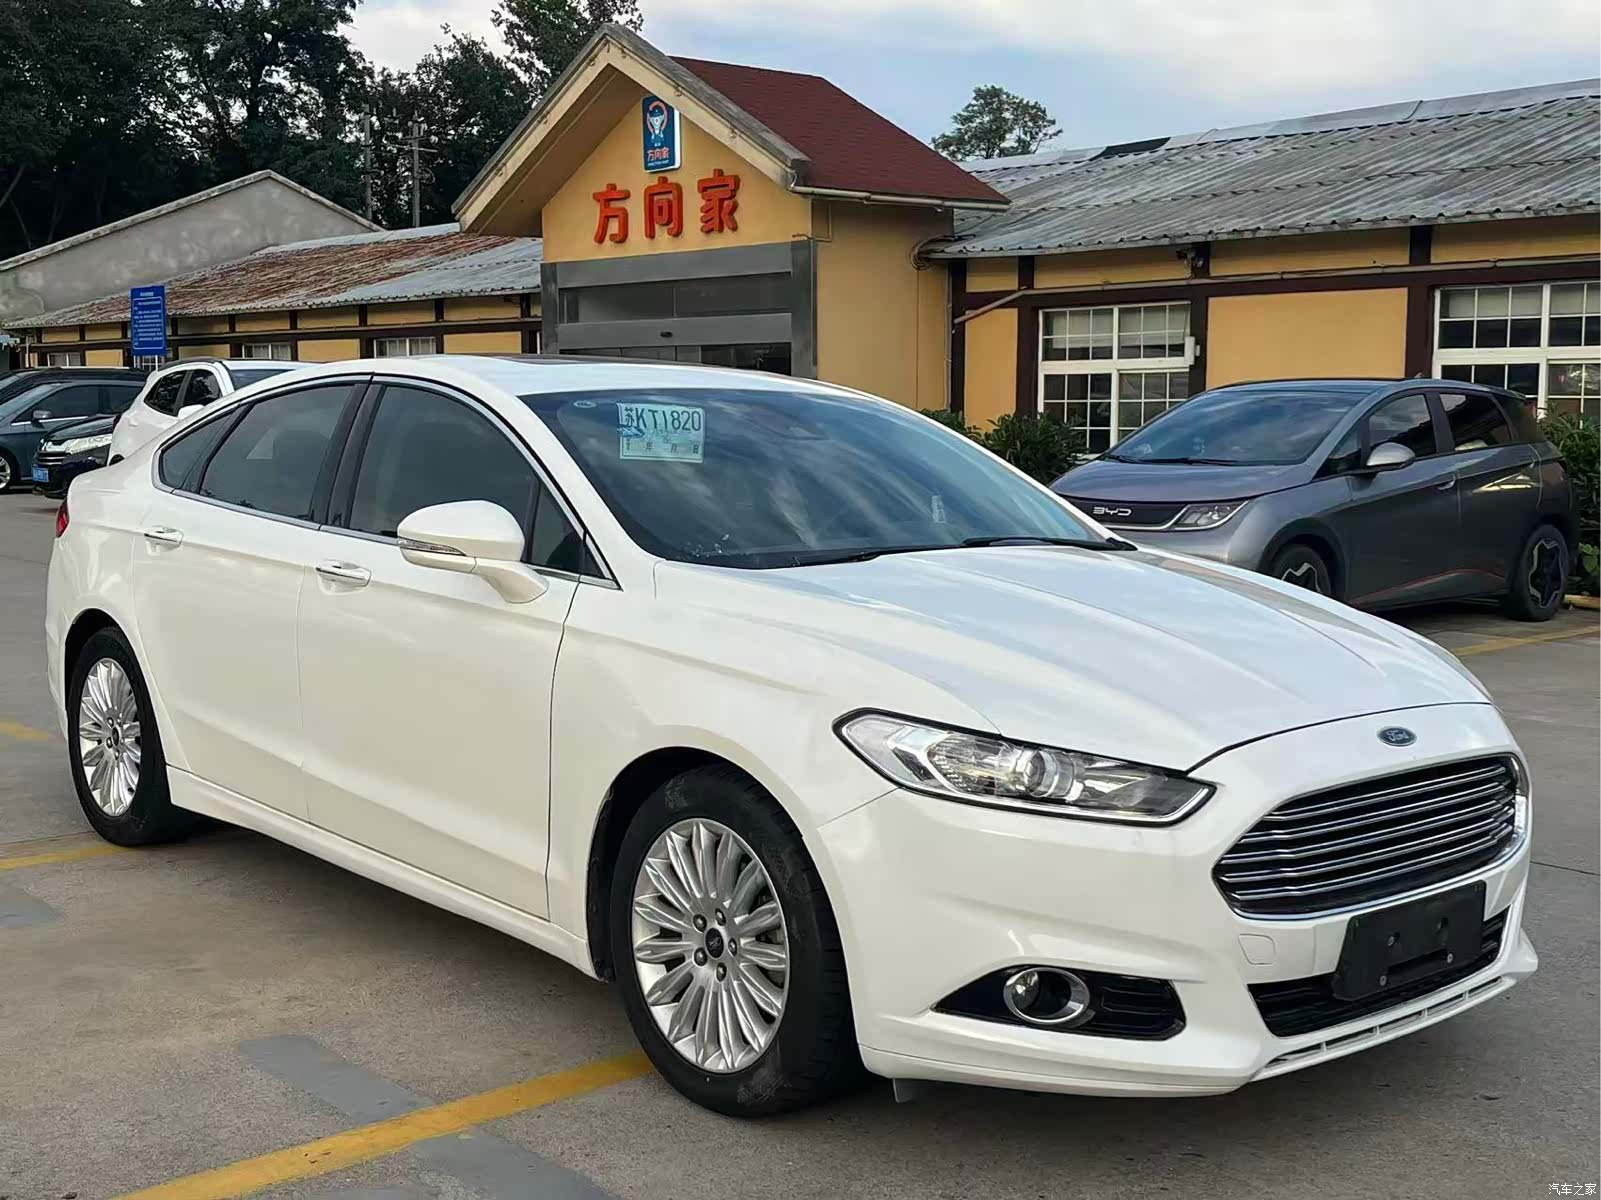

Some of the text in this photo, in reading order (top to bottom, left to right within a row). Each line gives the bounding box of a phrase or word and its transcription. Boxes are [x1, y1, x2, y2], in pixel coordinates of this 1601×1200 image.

[647, 147, 669, 161] 方向家
[593, 169, 740, 243] 方向家
[1093, 506, 1132, 516] BYD
